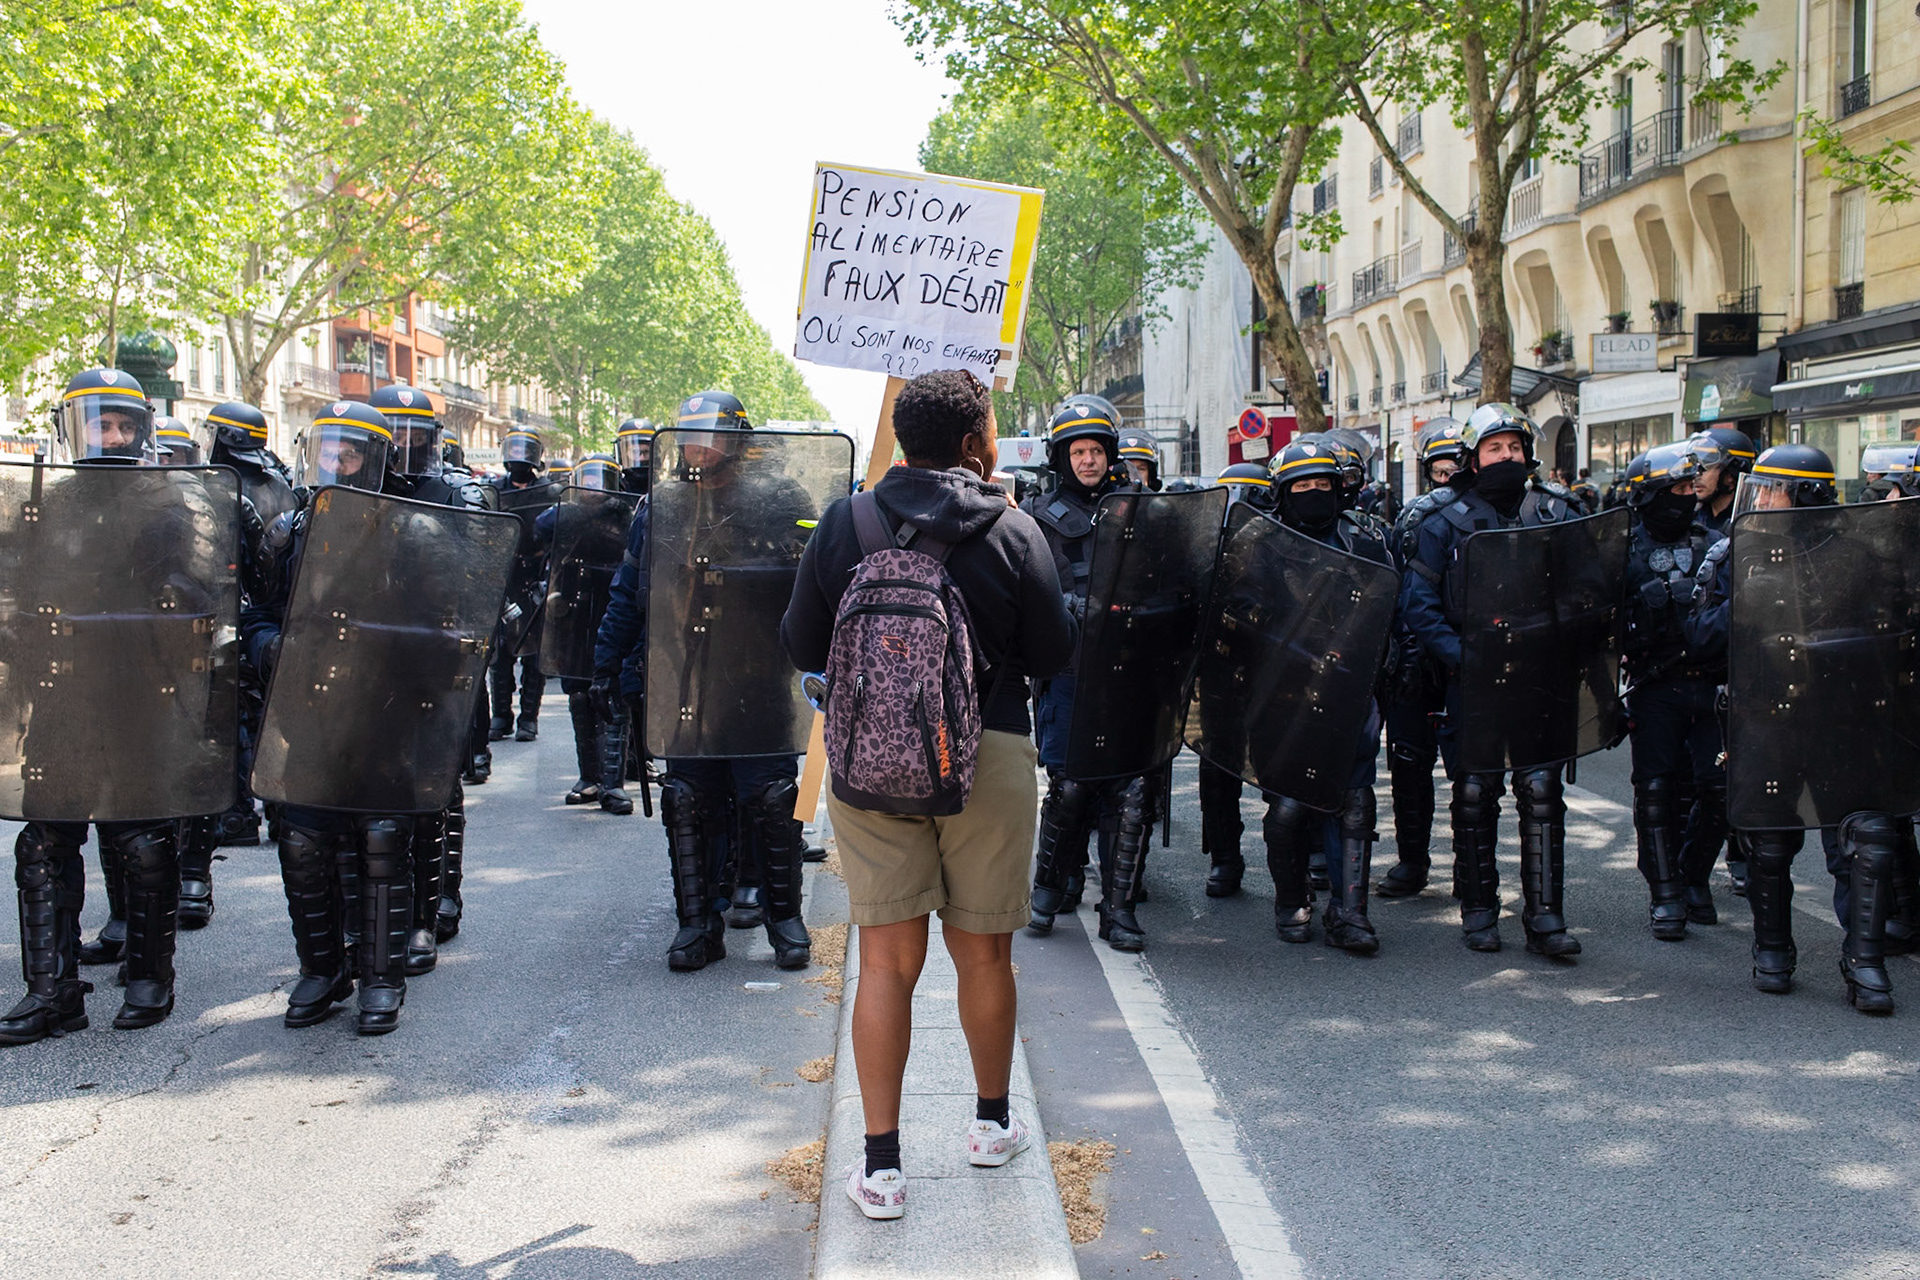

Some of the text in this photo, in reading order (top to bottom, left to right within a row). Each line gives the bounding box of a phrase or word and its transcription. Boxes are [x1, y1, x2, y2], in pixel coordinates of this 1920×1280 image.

[824, 259, 906, 305] FAUX
[851, 325, 896, 348] SONT
[902, 334, 934, 354] NOS
[1244, 393, 1268, 401] RAPPEL
